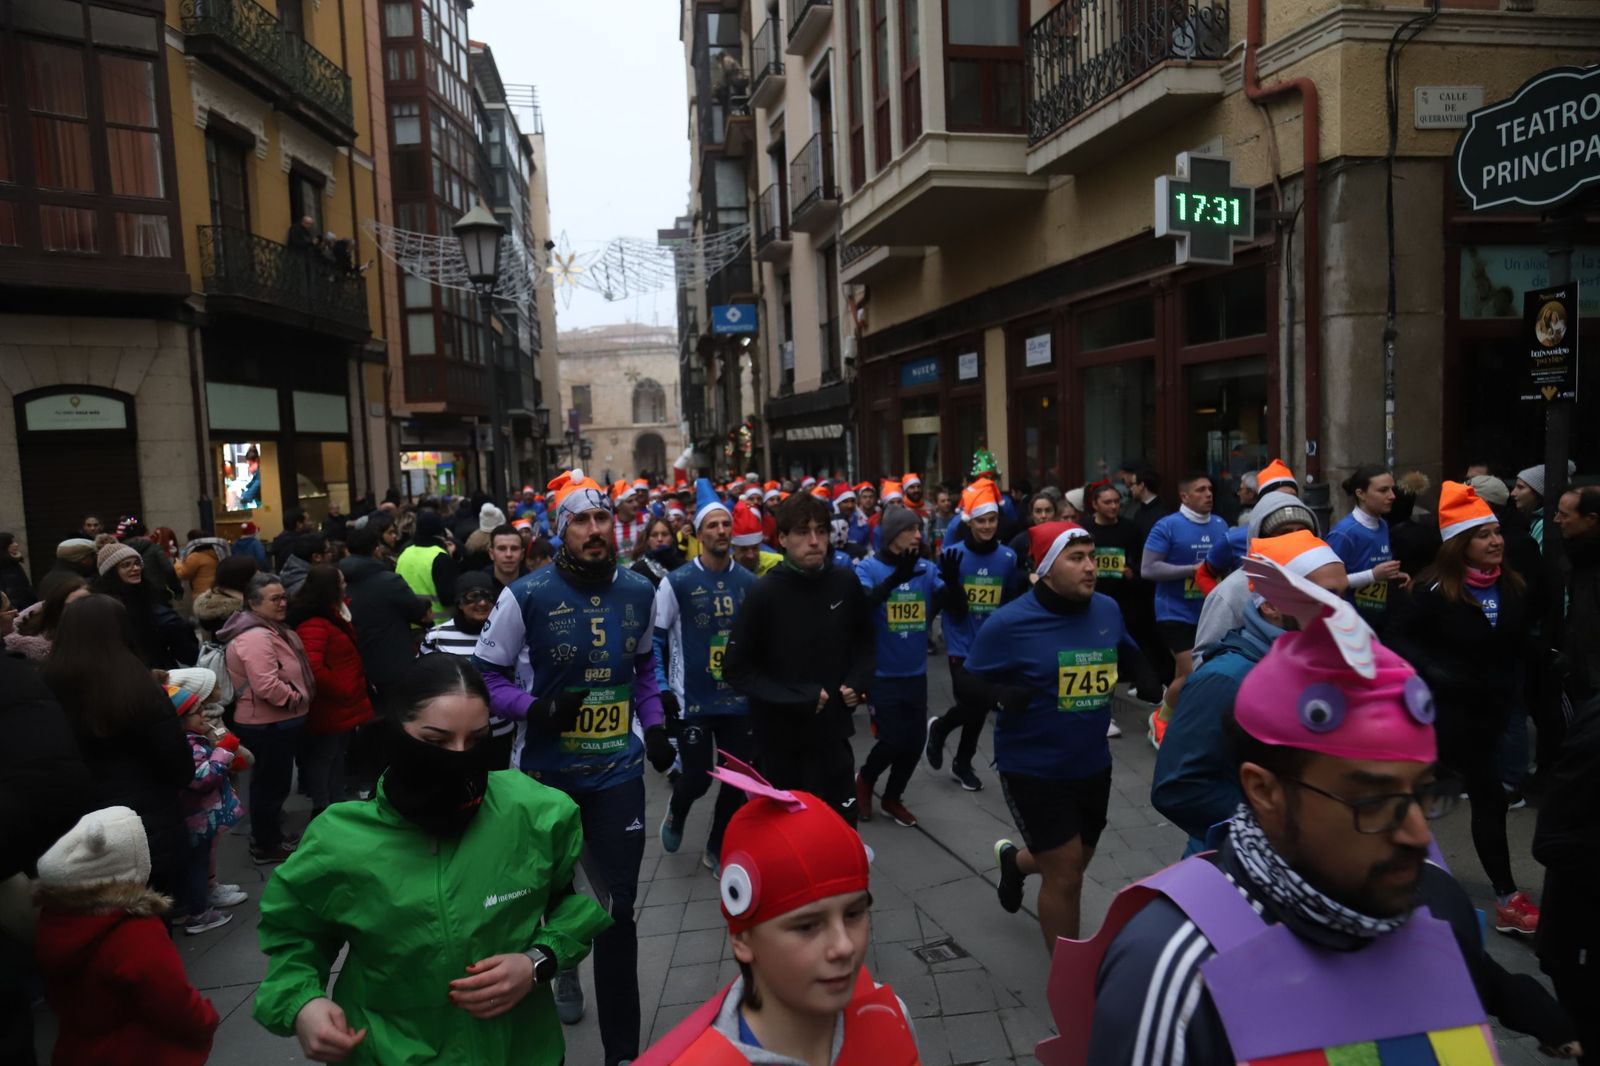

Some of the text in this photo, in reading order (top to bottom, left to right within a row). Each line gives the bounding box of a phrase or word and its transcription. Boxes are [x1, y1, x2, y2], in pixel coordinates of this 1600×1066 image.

[1440, 92, 1468, 101] CALLE
[1445, 103, 1456, 112] DE
[1496, 93, 1600, 147] TEATRO
[1482, 134, 1600, 190] PRINCIPA
[1175, 192, 1239, 226] 17:31
[1504, 257, 1521, 271] Un
[1523, 255, 1550, 271] aliad
[977, 568, 988, 576] 46
[968, 588, 996, 603] 621
[714, 596, 734, 617] 19
[891, 603, 920, 619] 1192
[591, 617, 606, 647] 5
[585, 668, 612, 682] gaza
[1063, 670, 1109, 695] 745
[581, 739, 624, 750] CAJA RURAL
